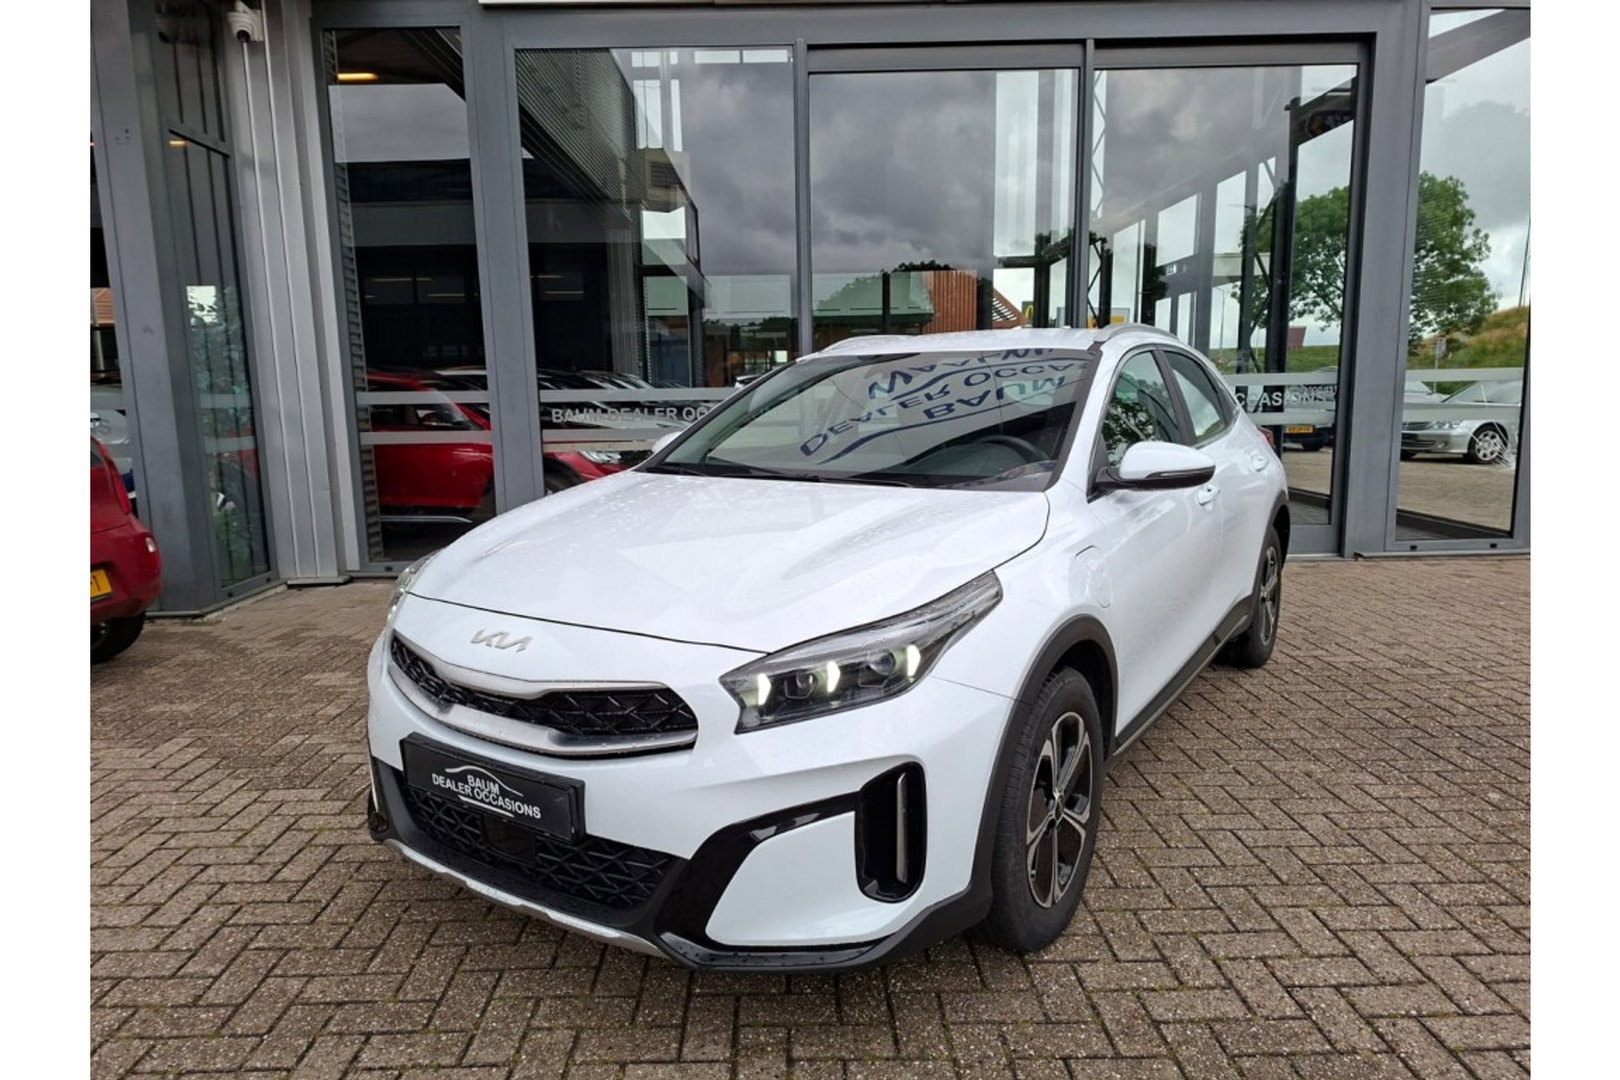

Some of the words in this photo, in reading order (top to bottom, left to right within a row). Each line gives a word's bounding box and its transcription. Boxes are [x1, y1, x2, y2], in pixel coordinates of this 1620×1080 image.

[551, 407, 602, 423] BAUM
[607, 407, 678, 421] DEALER
[682, 406, 710, 421] OC
[470, 628, 532, 653] KIA
[431, 772, 473, 797] DEALER
[473, 787, 542, 819] OCCASIONS
[466, 774, 500, 795] BAUM
